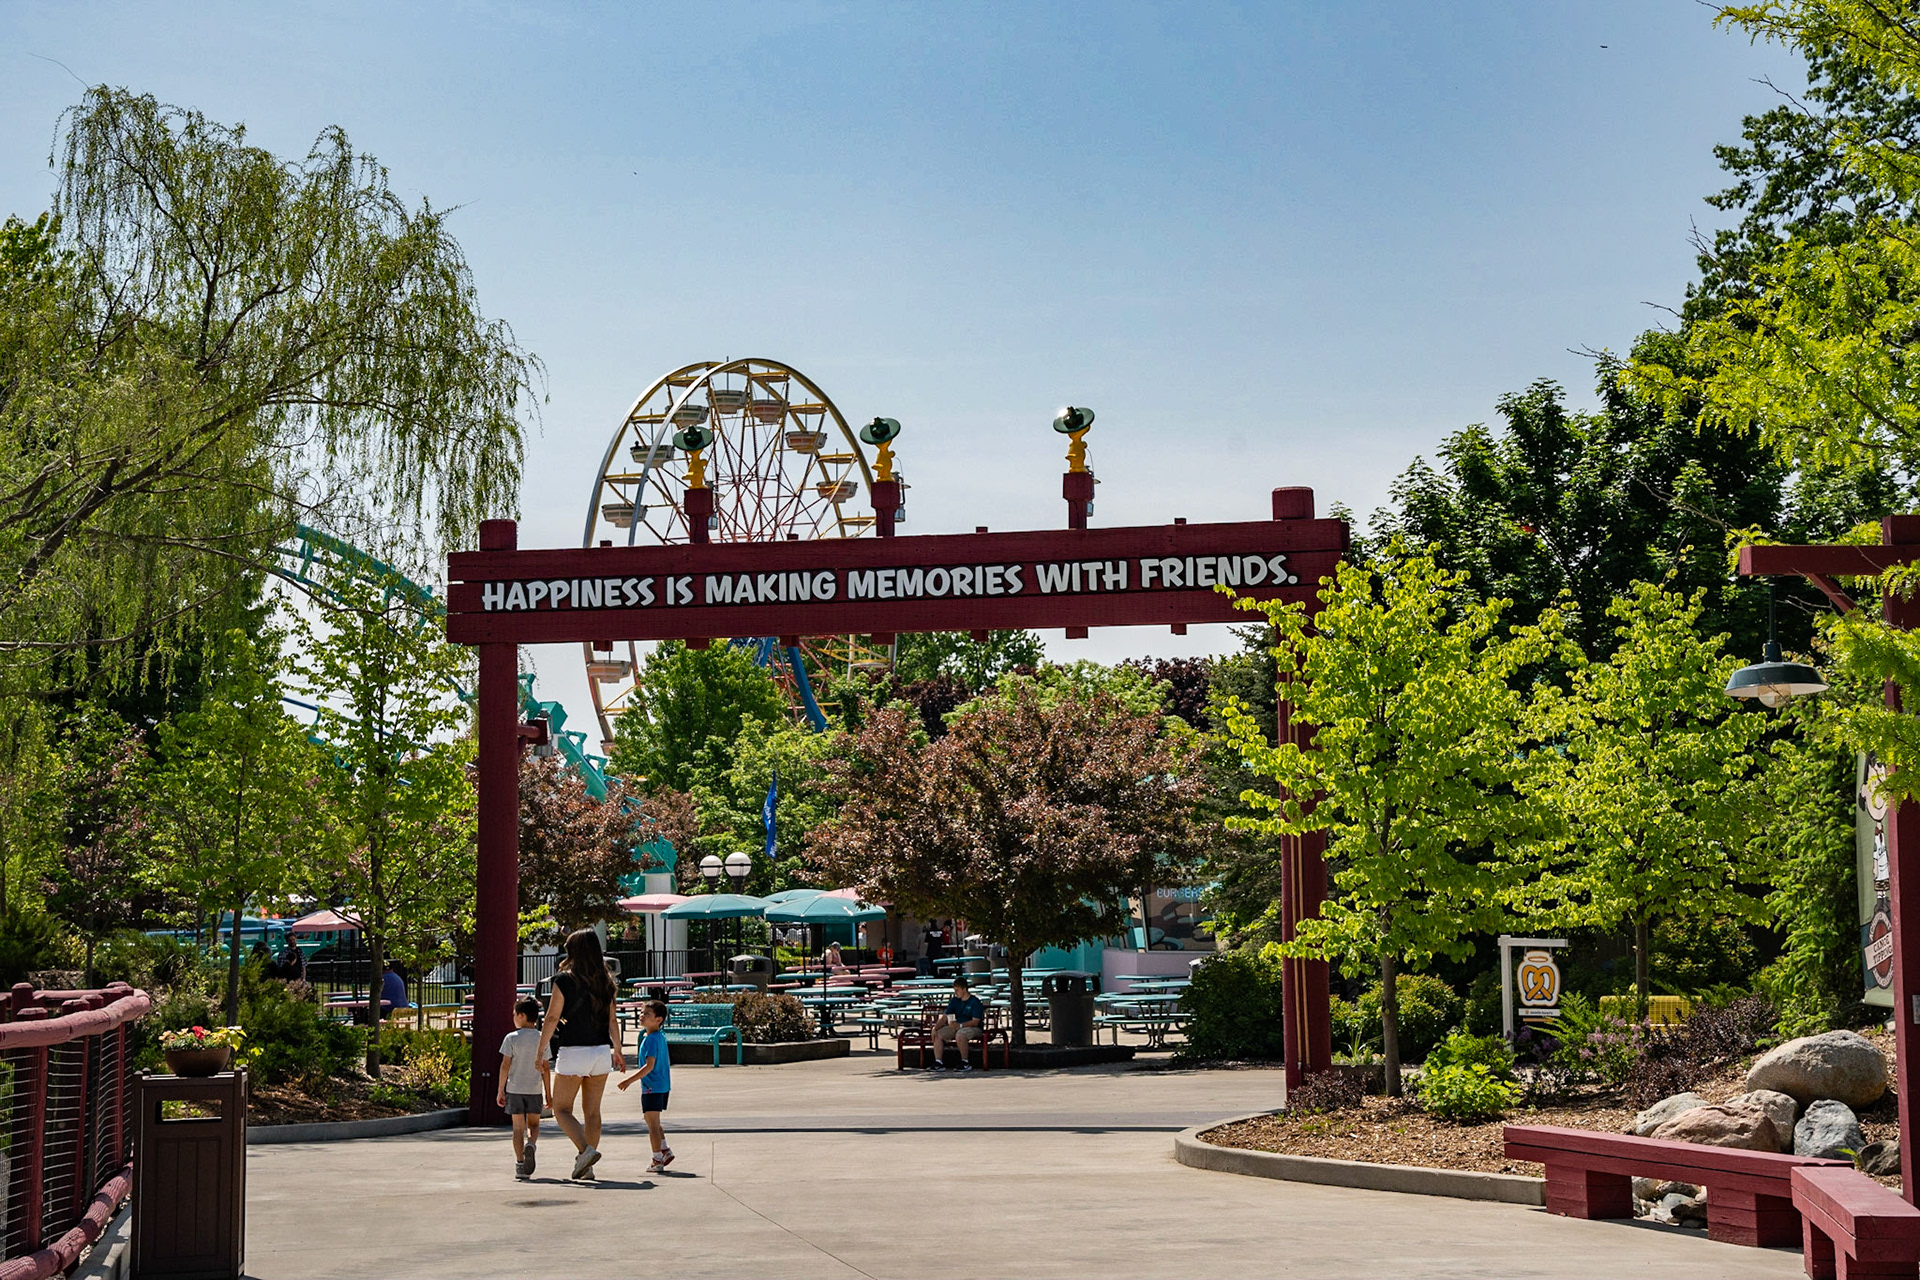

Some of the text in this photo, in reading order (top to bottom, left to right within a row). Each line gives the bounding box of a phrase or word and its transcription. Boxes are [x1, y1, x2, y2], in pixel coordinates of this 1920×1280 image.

[482, 554, 1298, 611] HAPPINESS IS MAKING MEMORIES WITH FRIENDS.
[1873, 935, 1890, 953] CANOE
[1873, 945, 1893, 964] TIPPING
